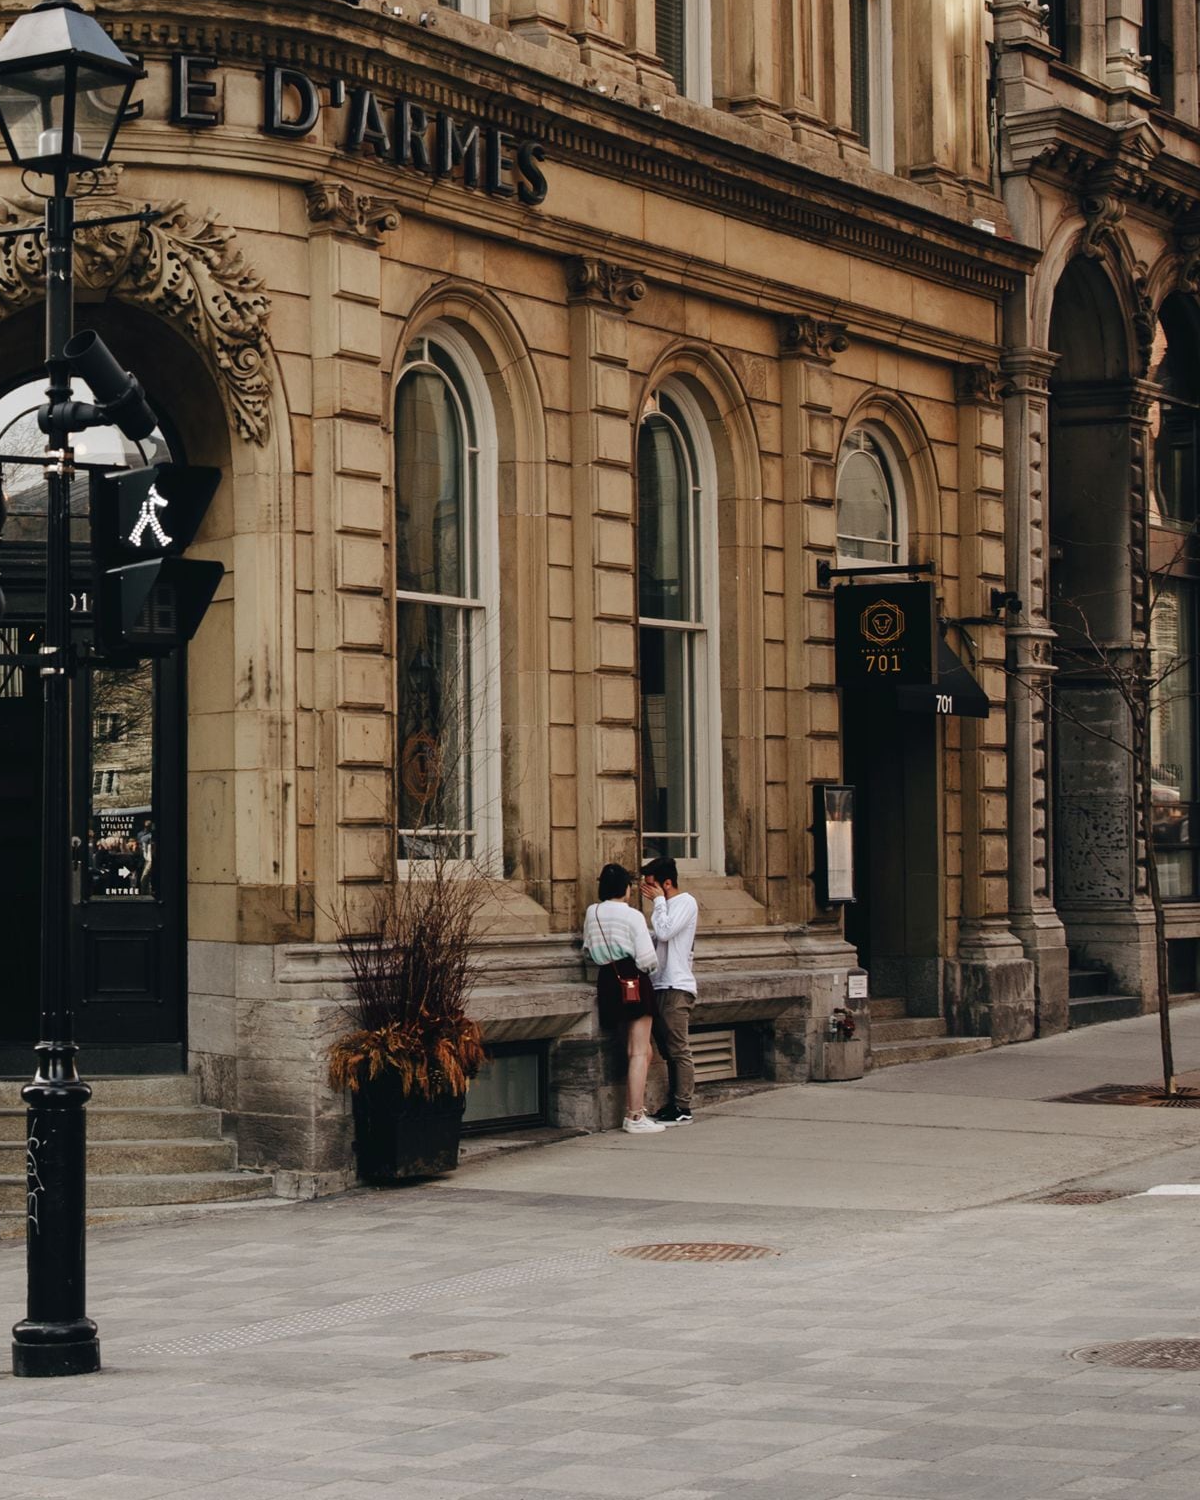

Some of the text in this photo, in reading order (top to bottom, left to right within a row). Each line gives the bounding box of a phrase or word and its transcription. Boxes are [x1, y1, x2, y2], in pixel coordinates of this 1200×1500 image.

[264, 60, 548, 206] D'ARMES
[866, 654, 902, 672] 701
[935, 694, 953, 714] 701
[105, 887, 140, 895] ENTRÉE
